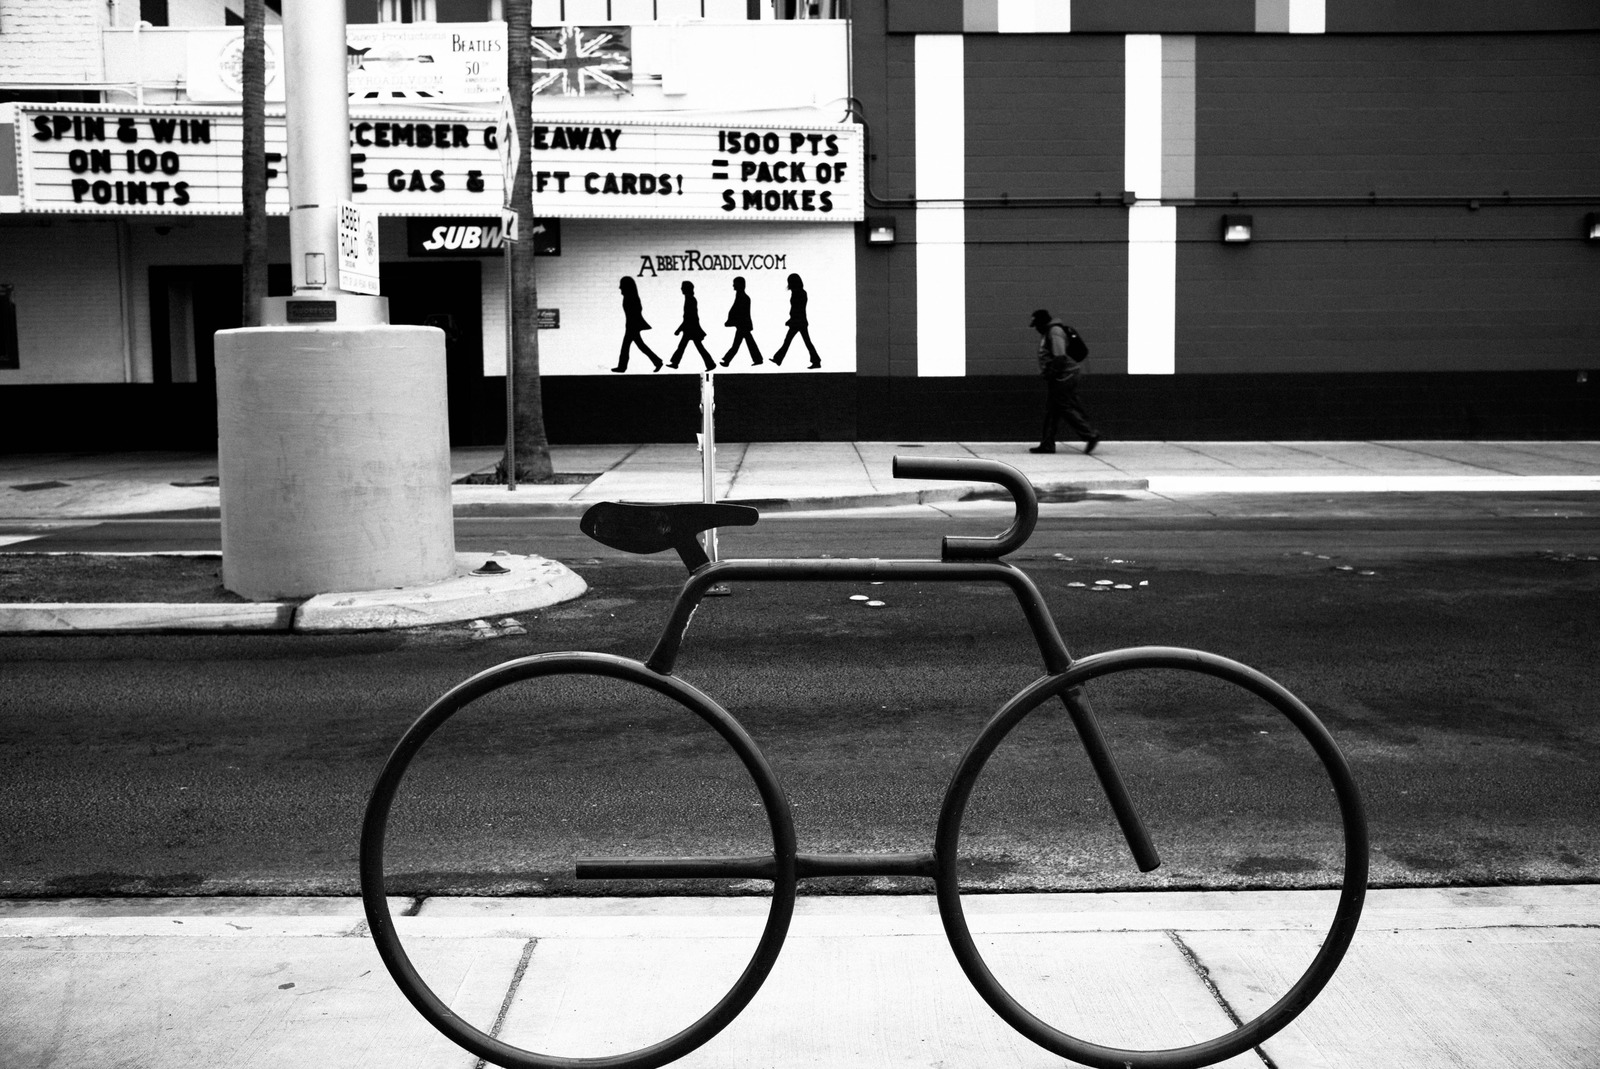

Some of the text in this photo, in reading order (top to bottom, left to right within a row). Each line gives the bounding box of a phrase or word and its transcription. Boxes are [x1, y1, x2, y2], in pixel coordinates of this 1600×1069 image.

[34, 115, 211, 144] SPIN & WIN
[350, 122, 622, 151] CEMBER GEAWAY
[718, 130, 839, 157] 1500 PTS
[68, 149, 180, 175] ON 100
[741, 161, 806, 184] PACK
[816, 162, 847, 184] OF
[71, 178, 190, 206] POINTS
[387, 169, 445, 193] GAS
[466, 170, 485, 193] &
[584, 172, 683, 195] CARDS!
[722, 189, 833, 213] SMOKES
[341, 232, 359, 260] ROAD
[422, 226, 505, 251] SUBW
